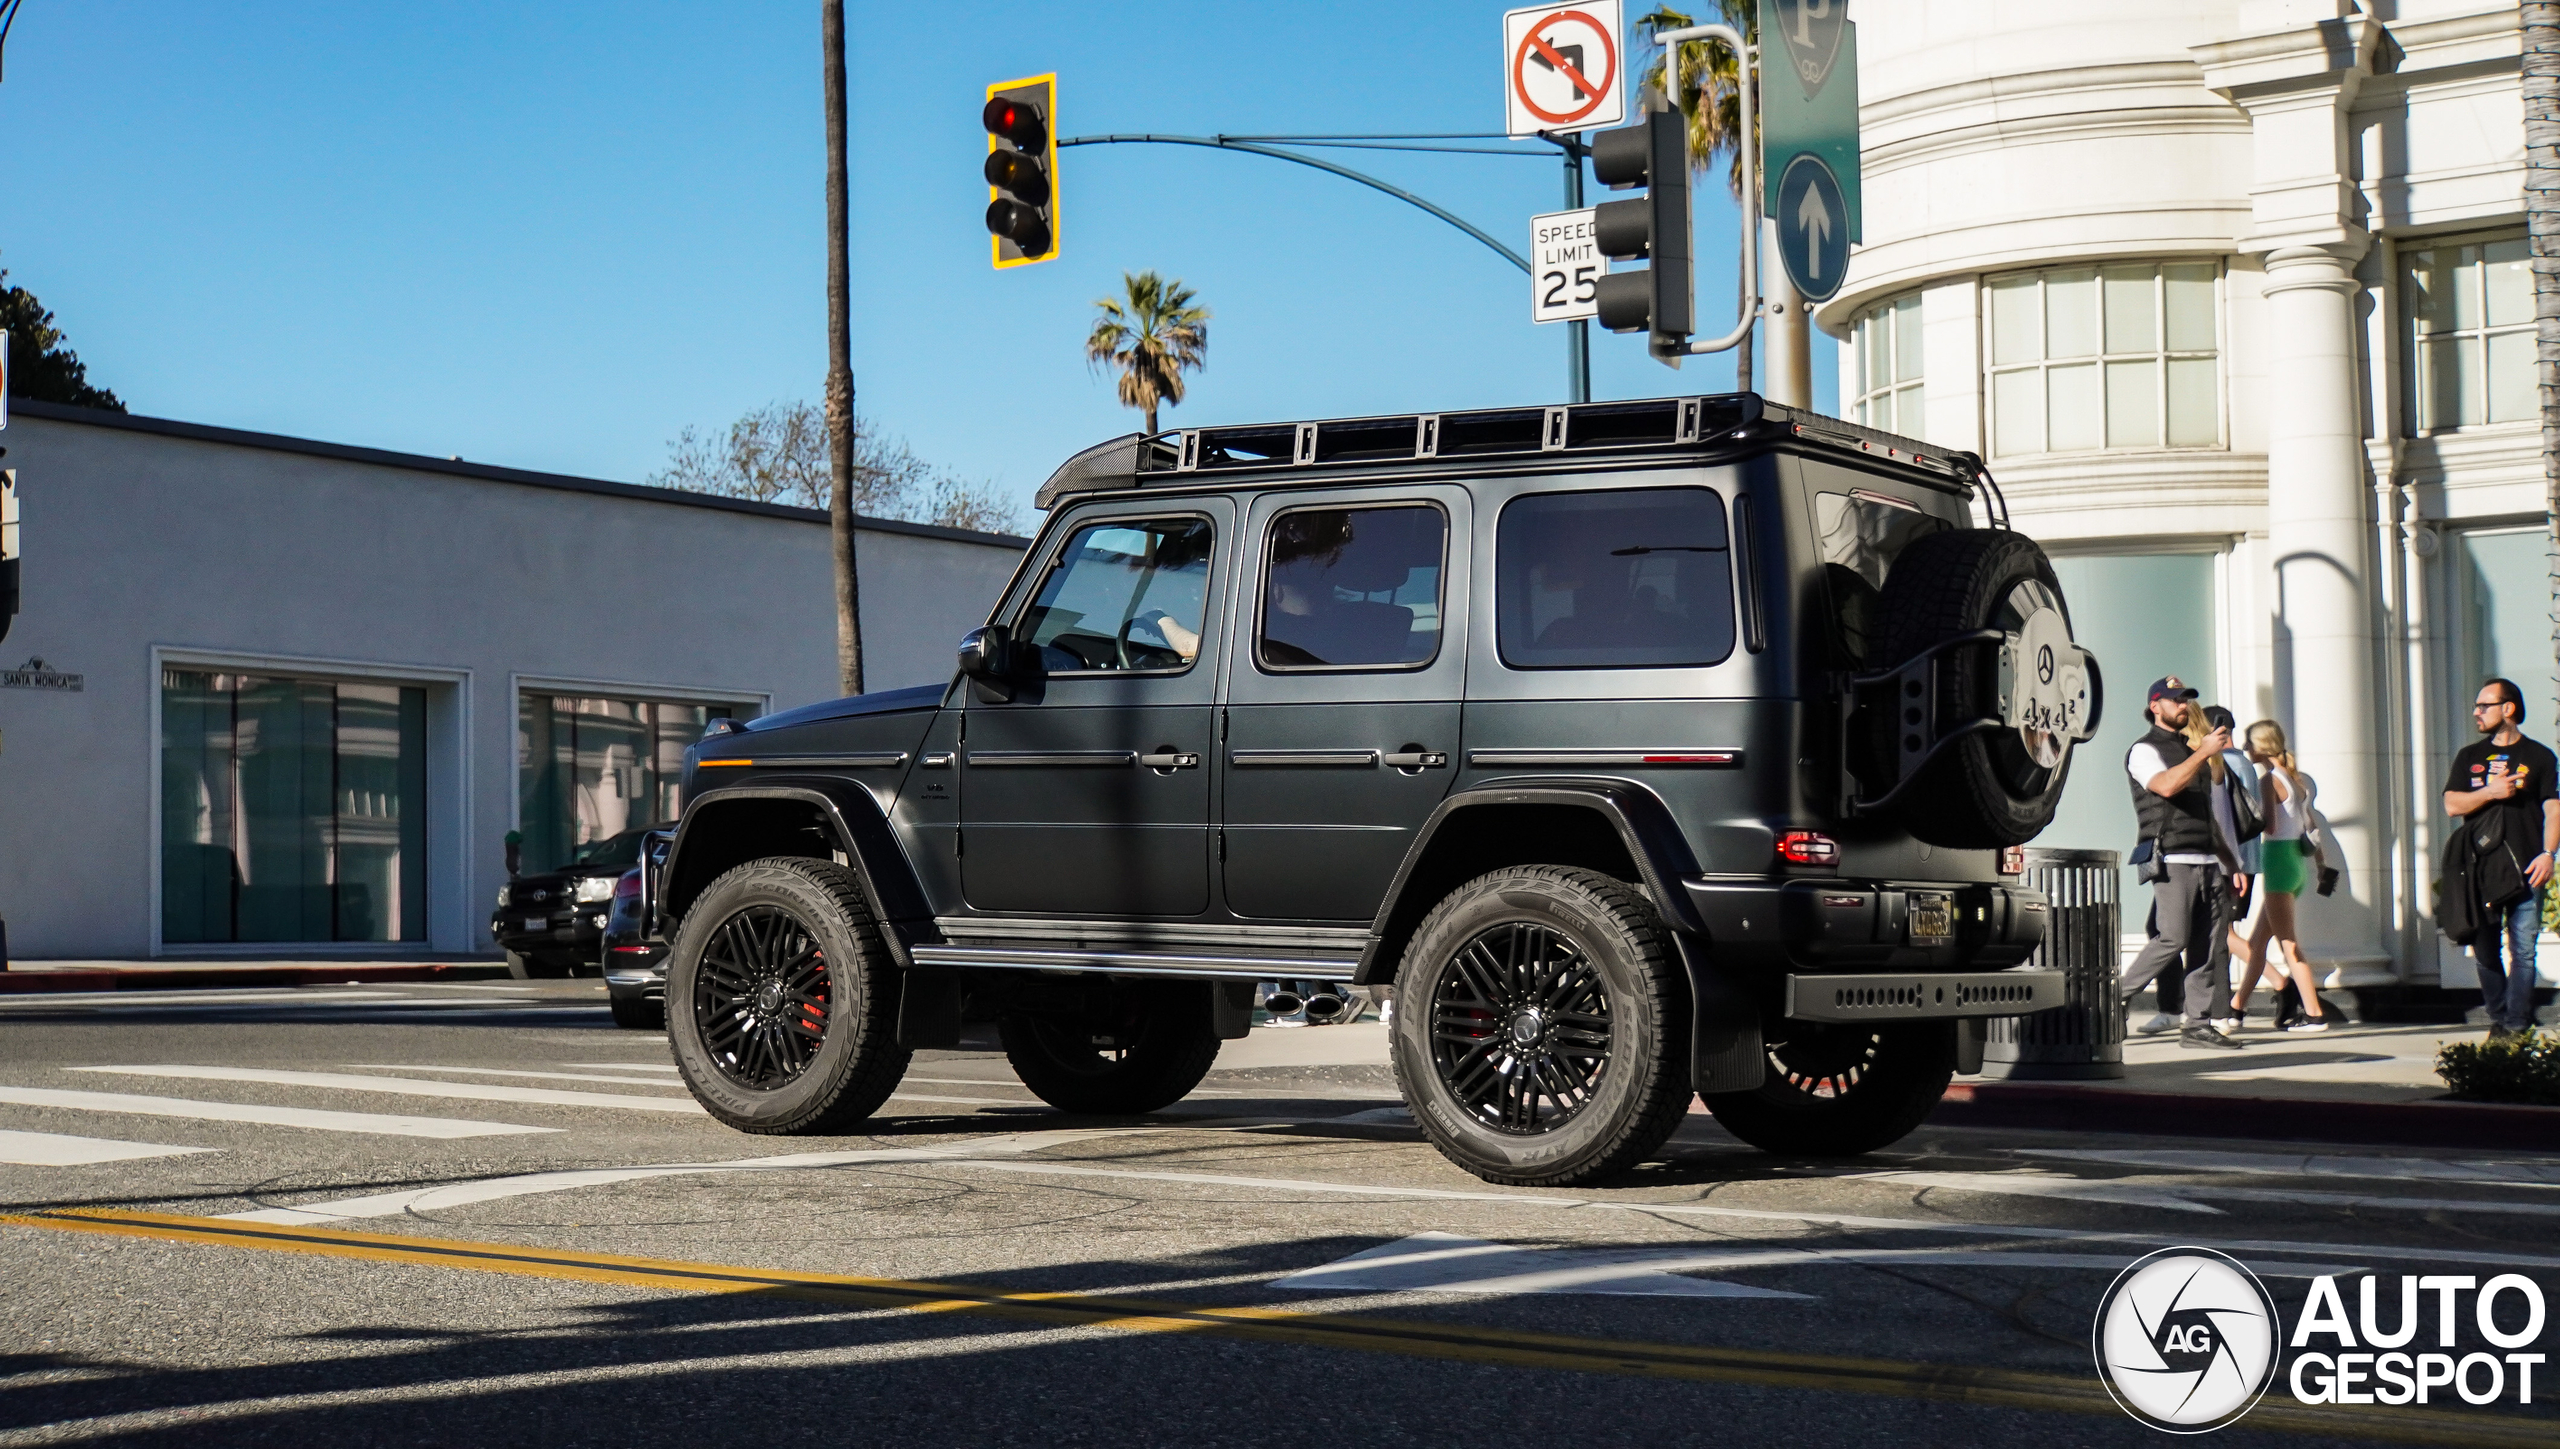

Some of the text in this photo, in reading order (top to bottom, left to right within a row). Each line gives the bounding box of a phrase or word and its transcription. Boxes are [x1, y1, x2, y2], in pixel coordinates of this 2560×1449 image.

[1546, 245, 1590, 265] LIMIT
[1543, 266, 1597, 308] 25
[4, 672, 31, 687] SANTA
[35, 673, 68, 689] MONICA
